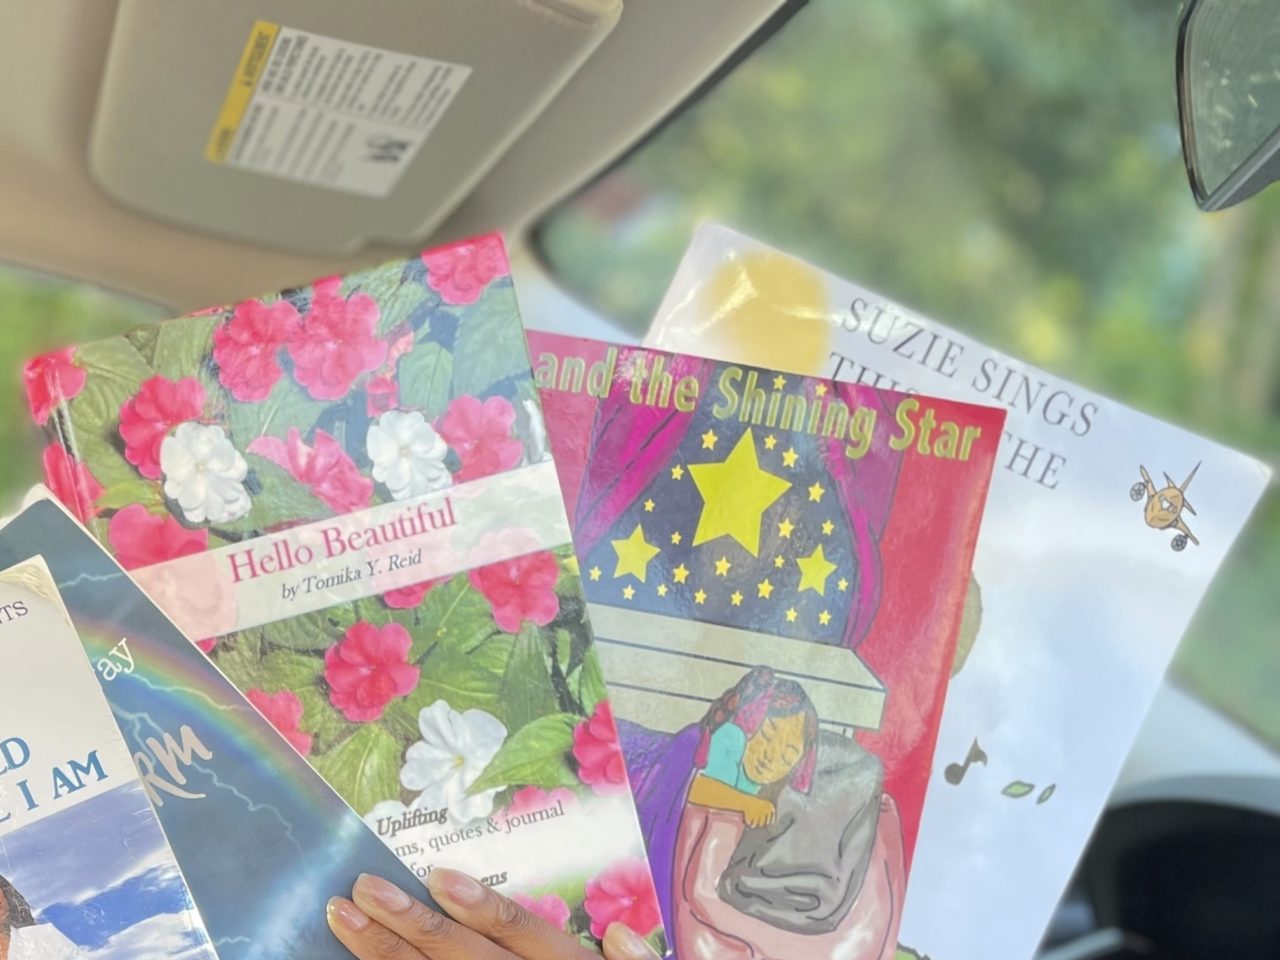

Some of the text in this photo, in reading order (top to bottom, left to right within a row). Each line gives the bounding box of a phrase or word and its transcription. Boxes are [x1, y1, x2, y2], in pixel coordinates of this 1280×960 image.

[840, 297, 1099, 437] SUZIE SINGS
[533, 346, 981, 462] and the Shining Star
[1002, 430, 1068, 490] HE
[227, 496, 458, 583] Hello Beautiful
[281, 548, 422, 602] by Tomika Y. Reid
[96, 637, 135, 681] ay
[22, 780, 40, 811] I
[51, 750, 109, 801] AM
[376, 807, 448, 838] Uplifting
[429, 825, 483, 852] quotes
[486, 818, 502, 834] &
[504, 800, 565, 834] journal
